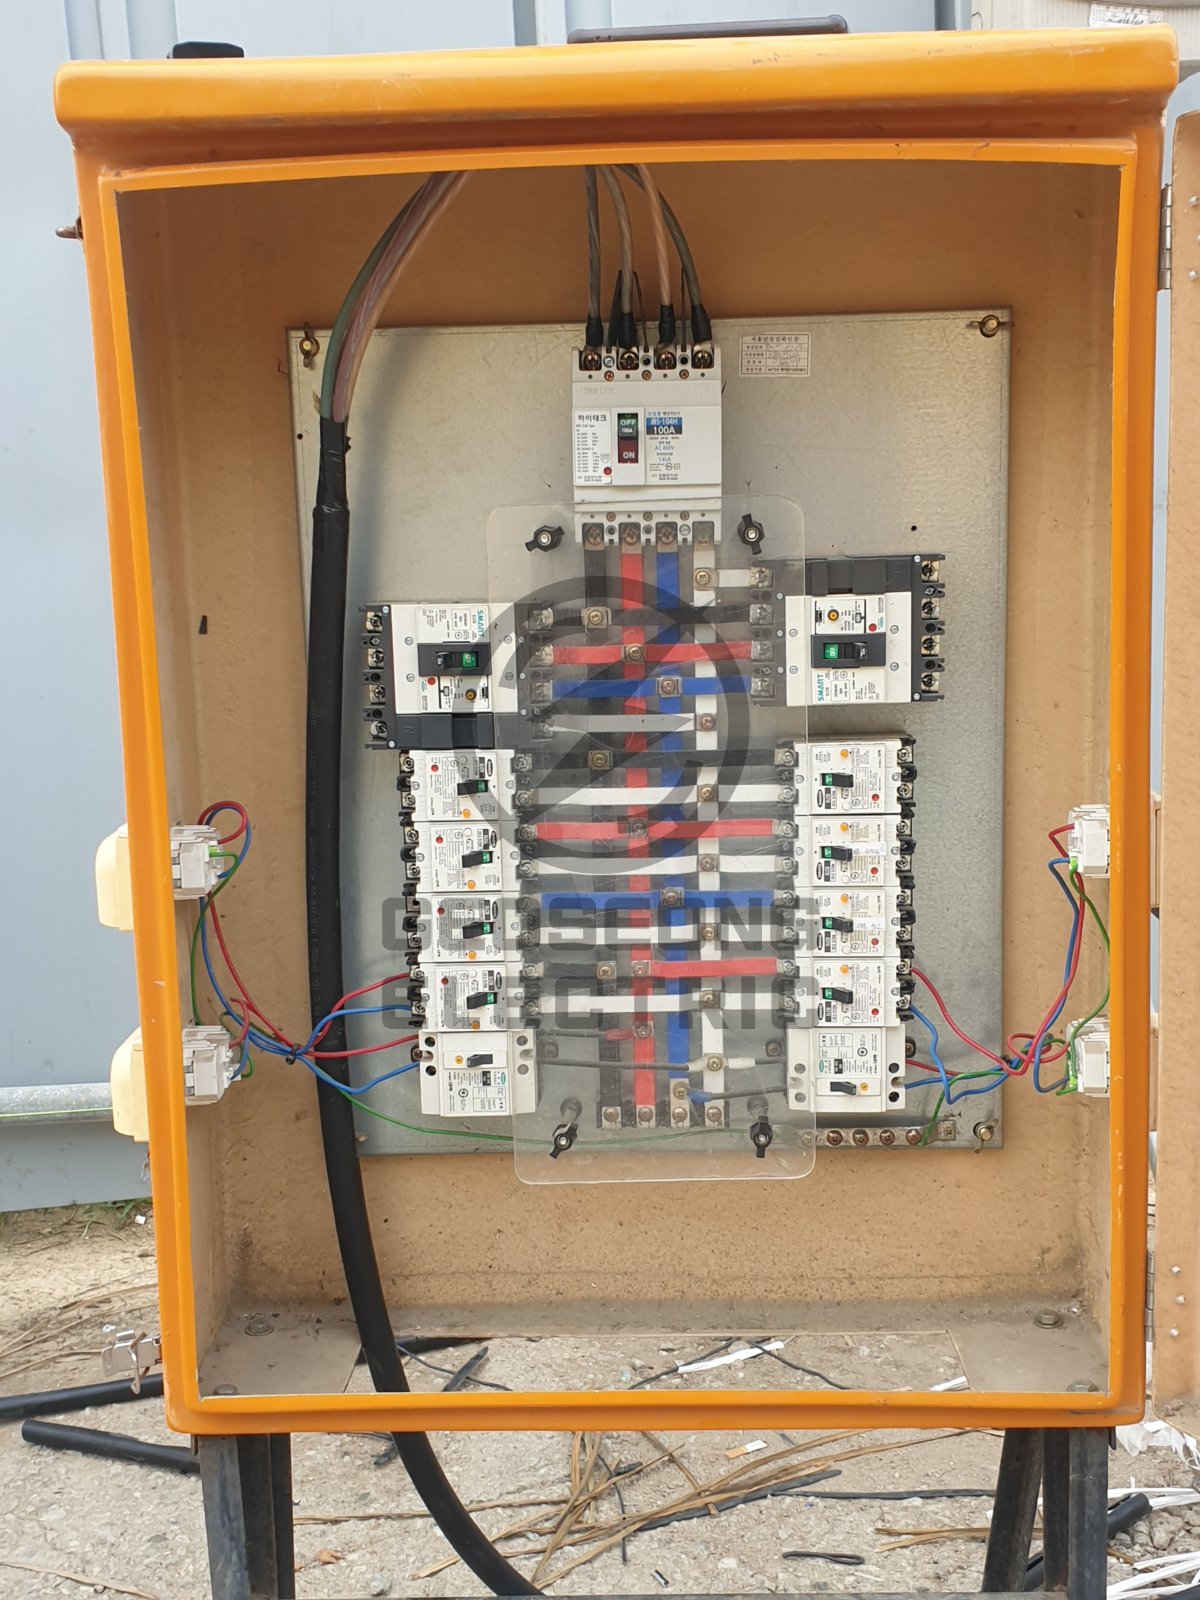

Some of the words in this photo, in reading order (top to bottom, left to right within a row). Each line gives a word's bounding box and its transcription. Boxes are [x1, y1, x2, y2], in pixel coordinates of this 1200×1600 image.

[578, 414, 607, 422] 하이테크
[653, 426, 676, 434] 100A
[623, 451, 635, 459] ON
[477, 609, 485, 638] SMART
[816, 674, 825, 702] SMART
